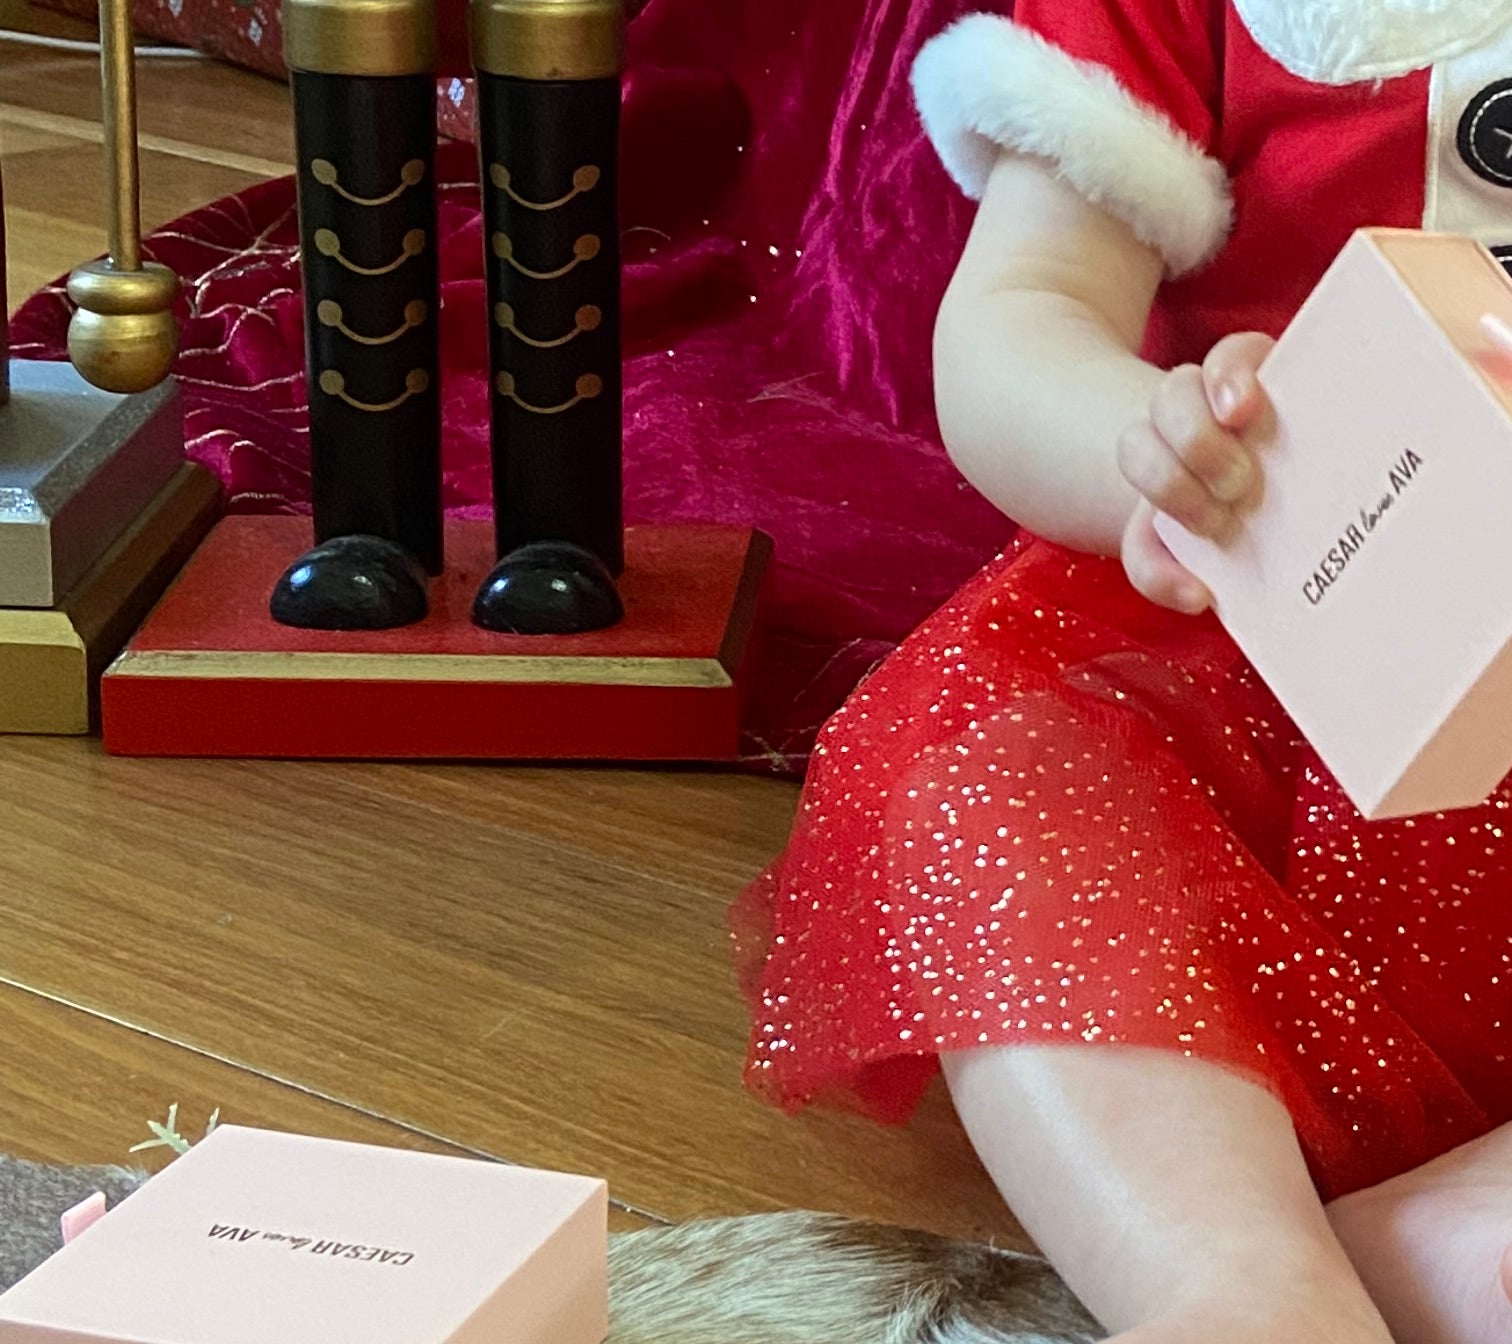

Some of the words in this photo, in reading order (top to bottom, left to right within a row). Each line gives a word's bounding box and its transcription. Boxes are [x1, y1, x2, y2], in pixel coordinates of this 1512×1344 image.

[1302, 523, 1365, 605] CAESAR
[1388, 448, 1424, 495] AVA
[207, 1224, 260, 1242] AVA
[311, 1239, 415, 1266] CAESAR
